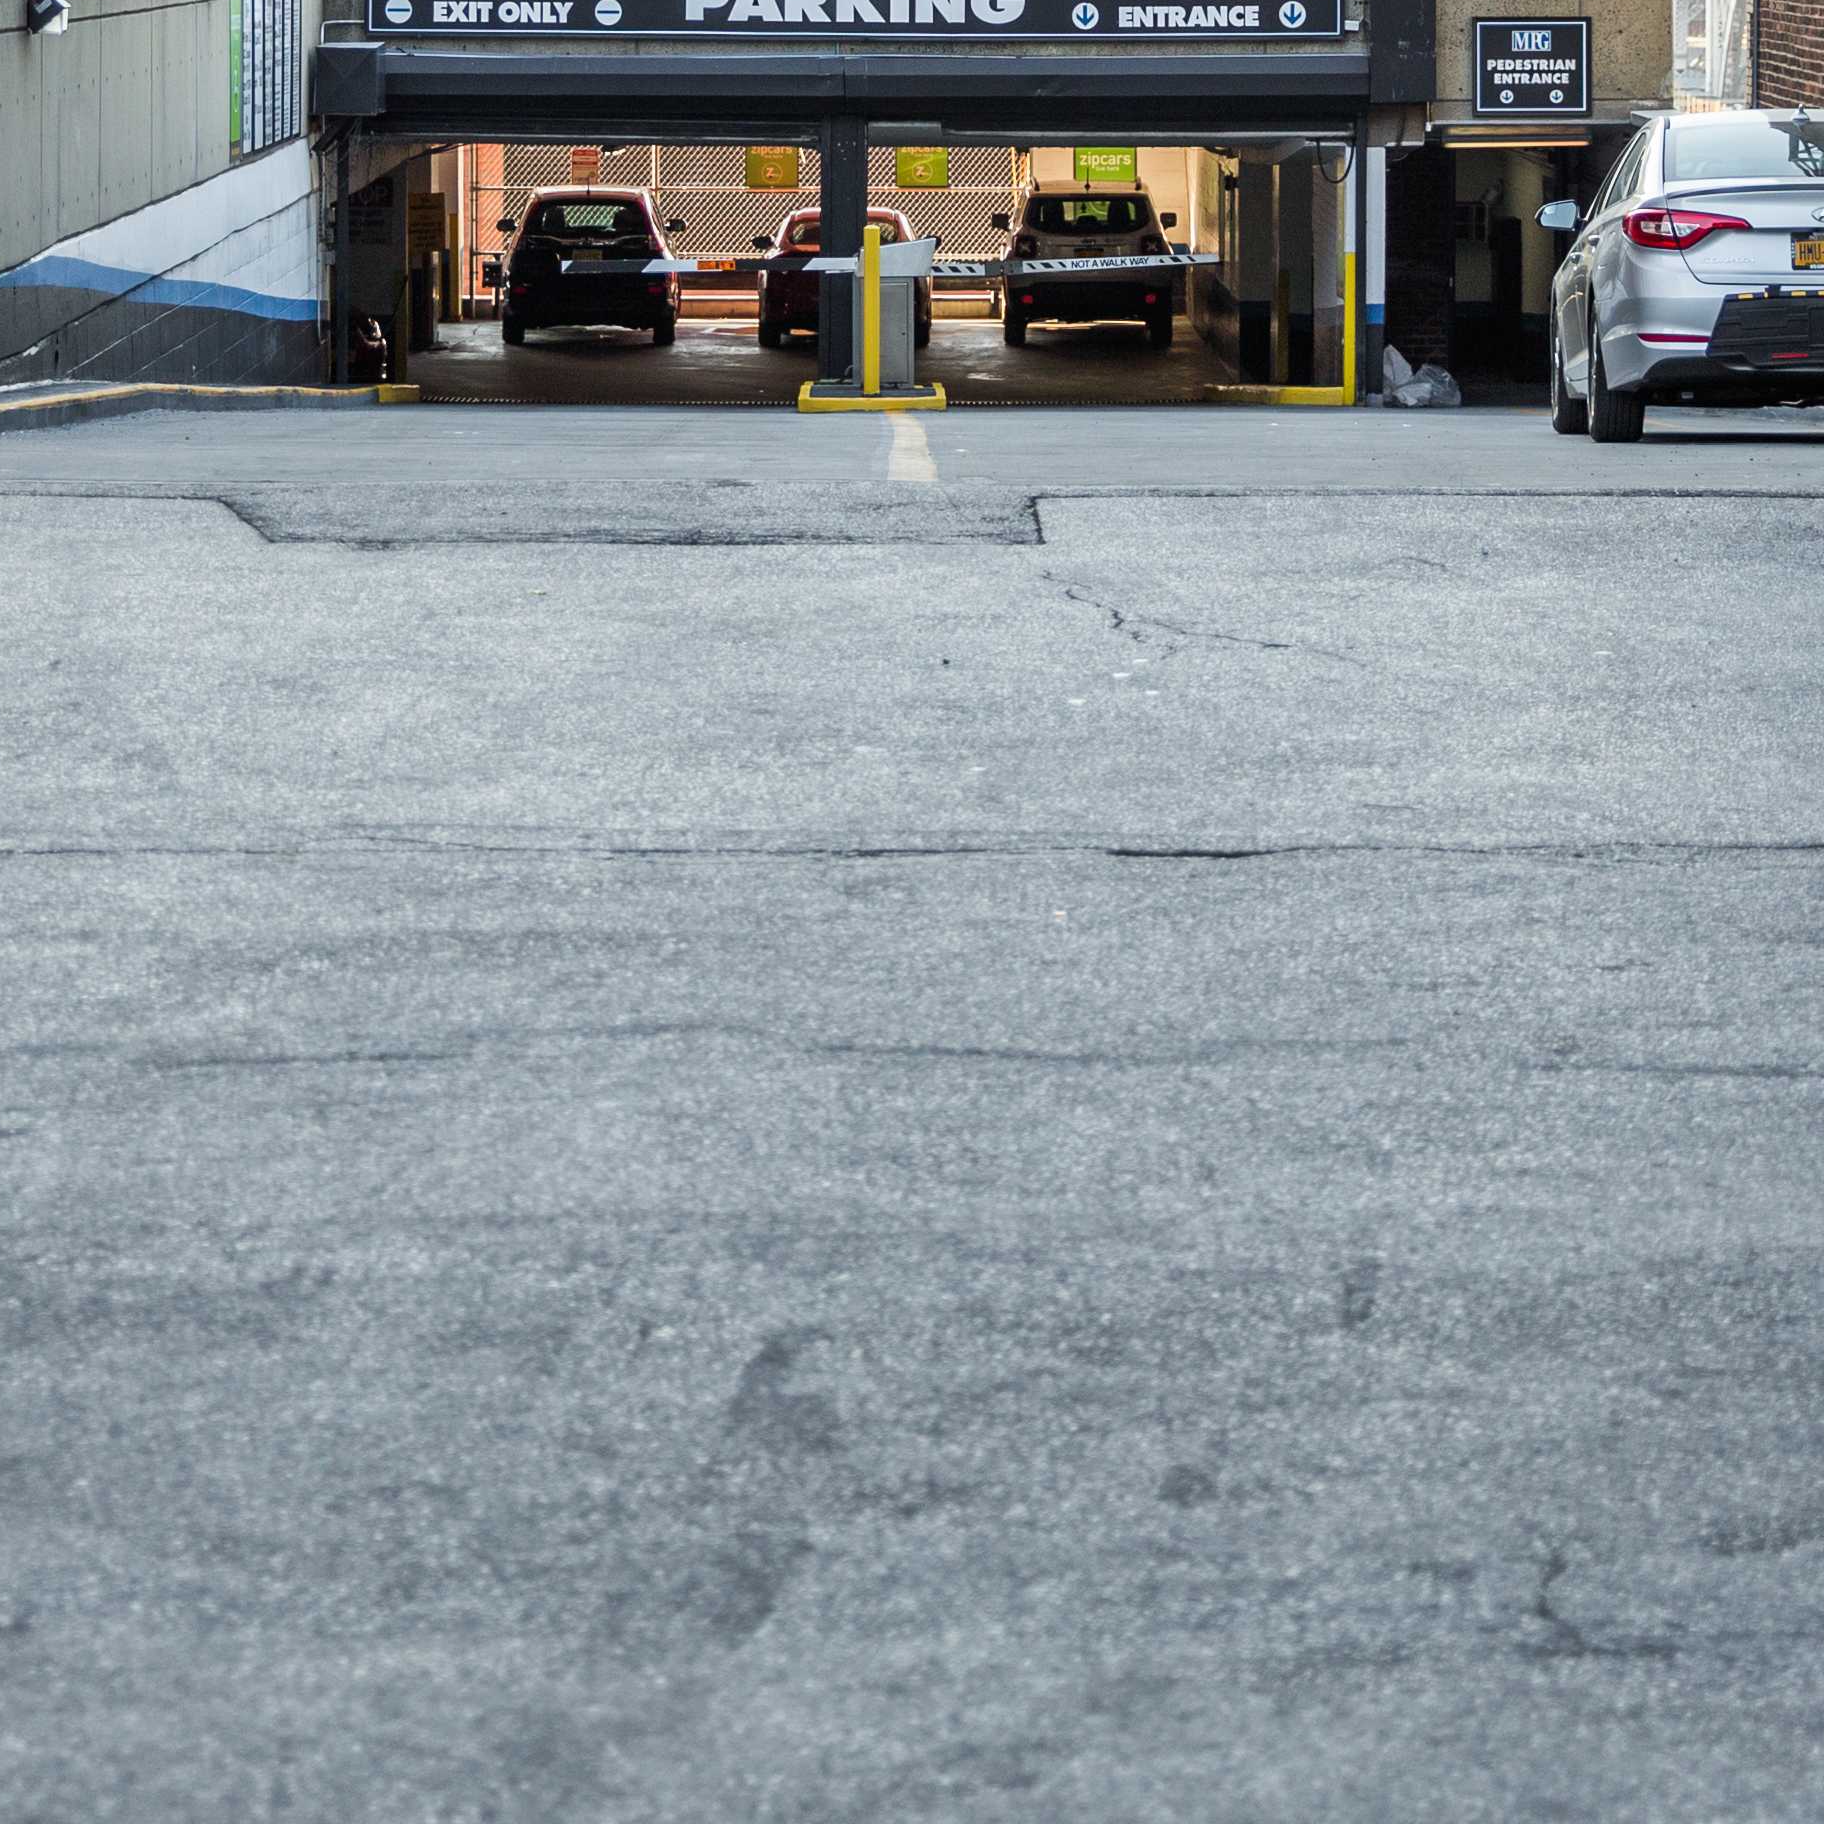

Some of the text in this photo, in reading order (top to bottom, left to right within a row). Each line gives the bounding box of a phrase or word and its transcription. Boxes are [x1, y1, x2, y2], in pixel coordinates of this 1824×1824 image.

[433, 1, 574, 23] EXIT ONLY
[1118, 5, 1260, 28] ENTRANCE
[1486, 59, 1576, 71] PEDESTRIAN
[1493, 73, 1570, 84] ENTRANCE
[1079, 151, 1132, 168] zipcars
[1071, 257, 1149, 269] NOT A WALK WAY
